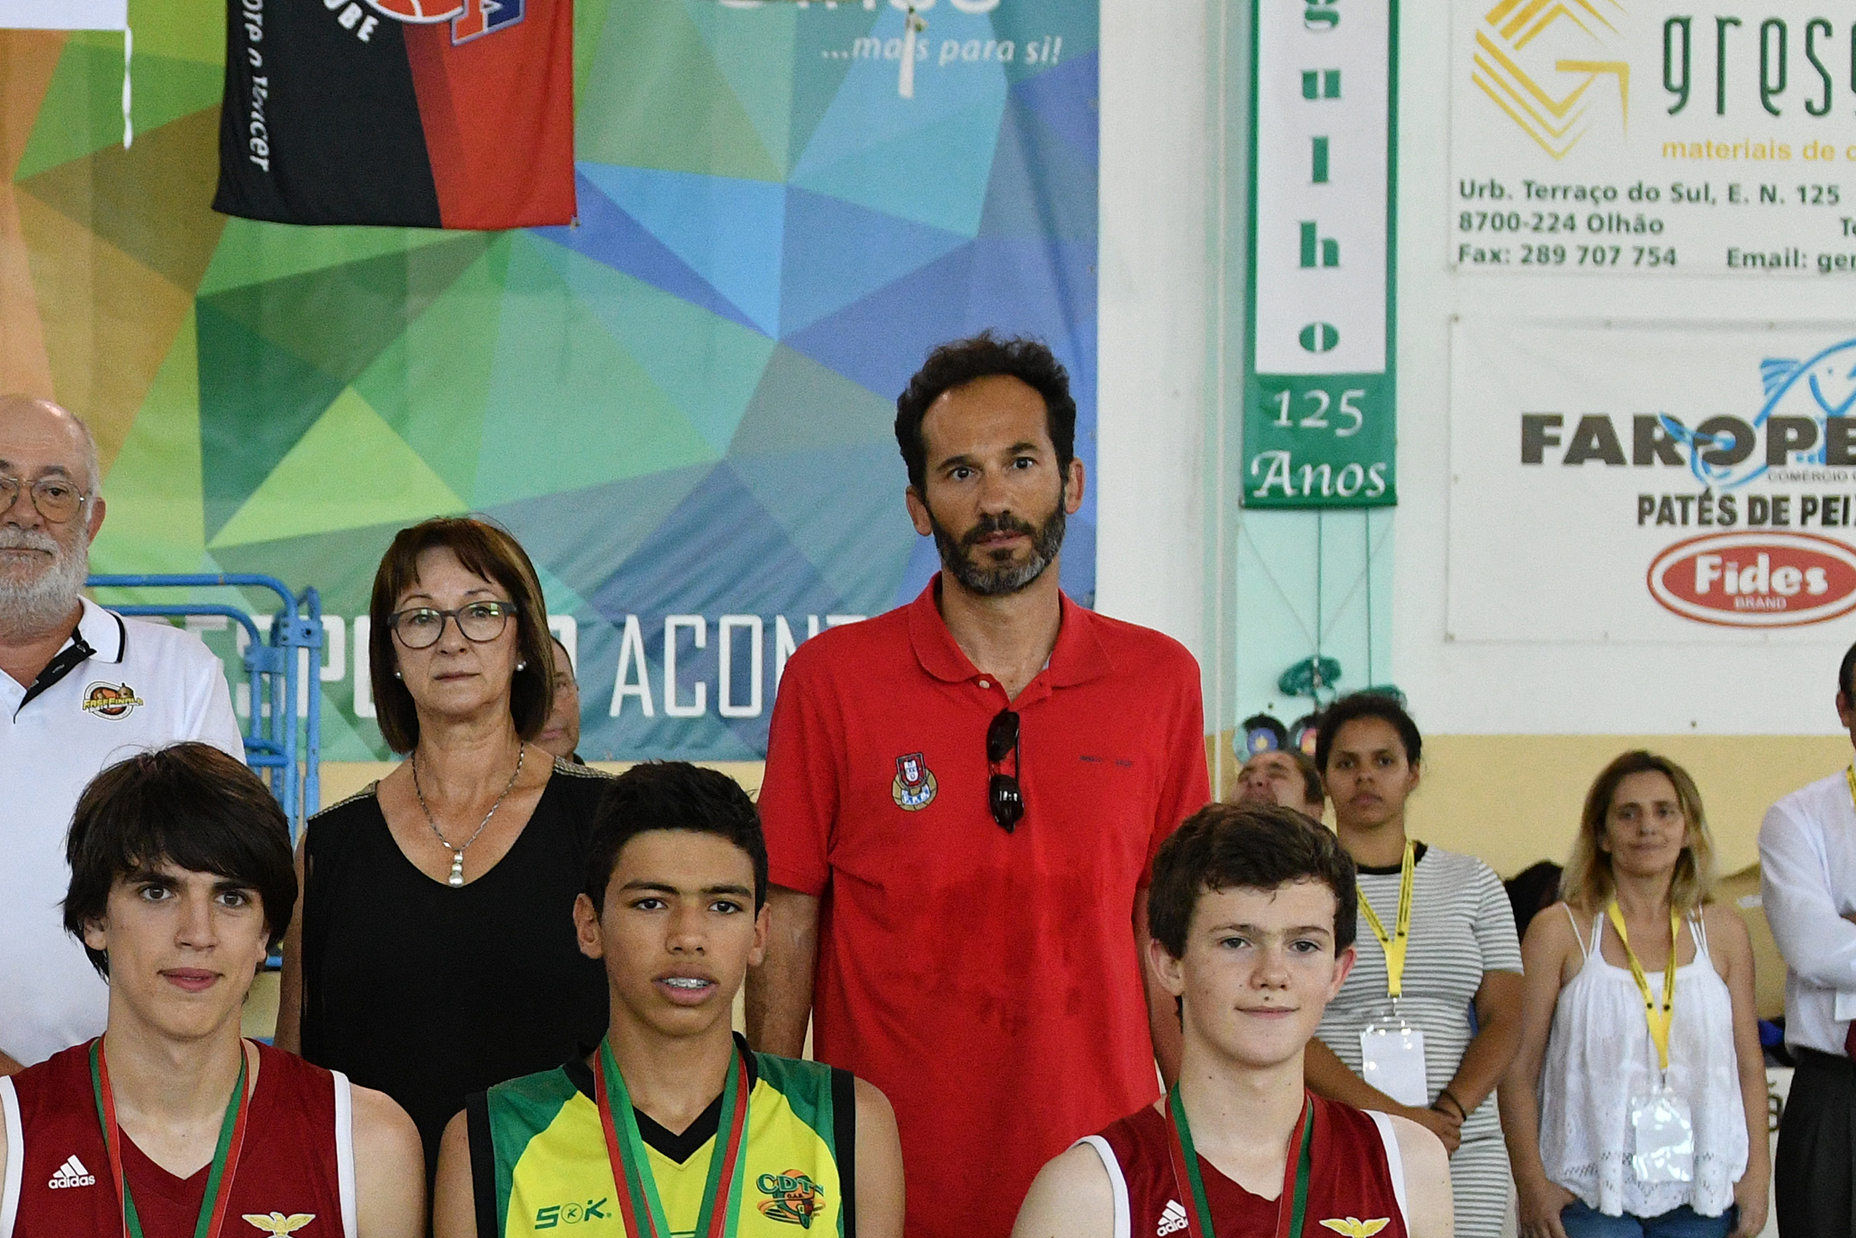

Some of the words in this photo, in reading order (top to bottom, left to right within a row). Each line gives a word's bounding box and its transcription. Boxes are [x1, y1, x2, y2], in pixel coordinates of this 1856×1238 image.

[939, 38, 1015, 66] para
[1025, 35, 1063, 64] si!
[1662, 138, 1792, 161] materiais
[1802, 139, 1836, 162] de
[1459, 179, 1513, 201] Urb.
[1523, 180, 1618, 206] Terraço
[1627, 180, 1661, 203] do
[1670, 182, 1717, 207] Sul,
[1727, 184, 1749, 205] E.
[1759, 184, 1785, 205] N.
[1797, 184, 1840, 205] 125
[1458, 212, 1577, 233] 8700-224
[1586, 212, 1665, 234] Olhão
[1458, 243, 1511, 265] Fax:
[1520, 244, 1567, 266] 289
[1576, 245, 1622, 266] 707
[1632, 245, 1677, 267] 754
[1726, 246, 1808, 269] Email:
[1273, 388, 1365, 437] 125
[1250, 449, 1387, 498] Anos
[1637, 487, 1738, 526] PATÉS
[1747, 494, 1791, 526] DE
[1801, 494, 1856, 526] PEI
[1695, 552, 1829, 597] Fides
[1734, 596, 1787, 610] BRAND
[48, 1172, 96, 1189] adidas
